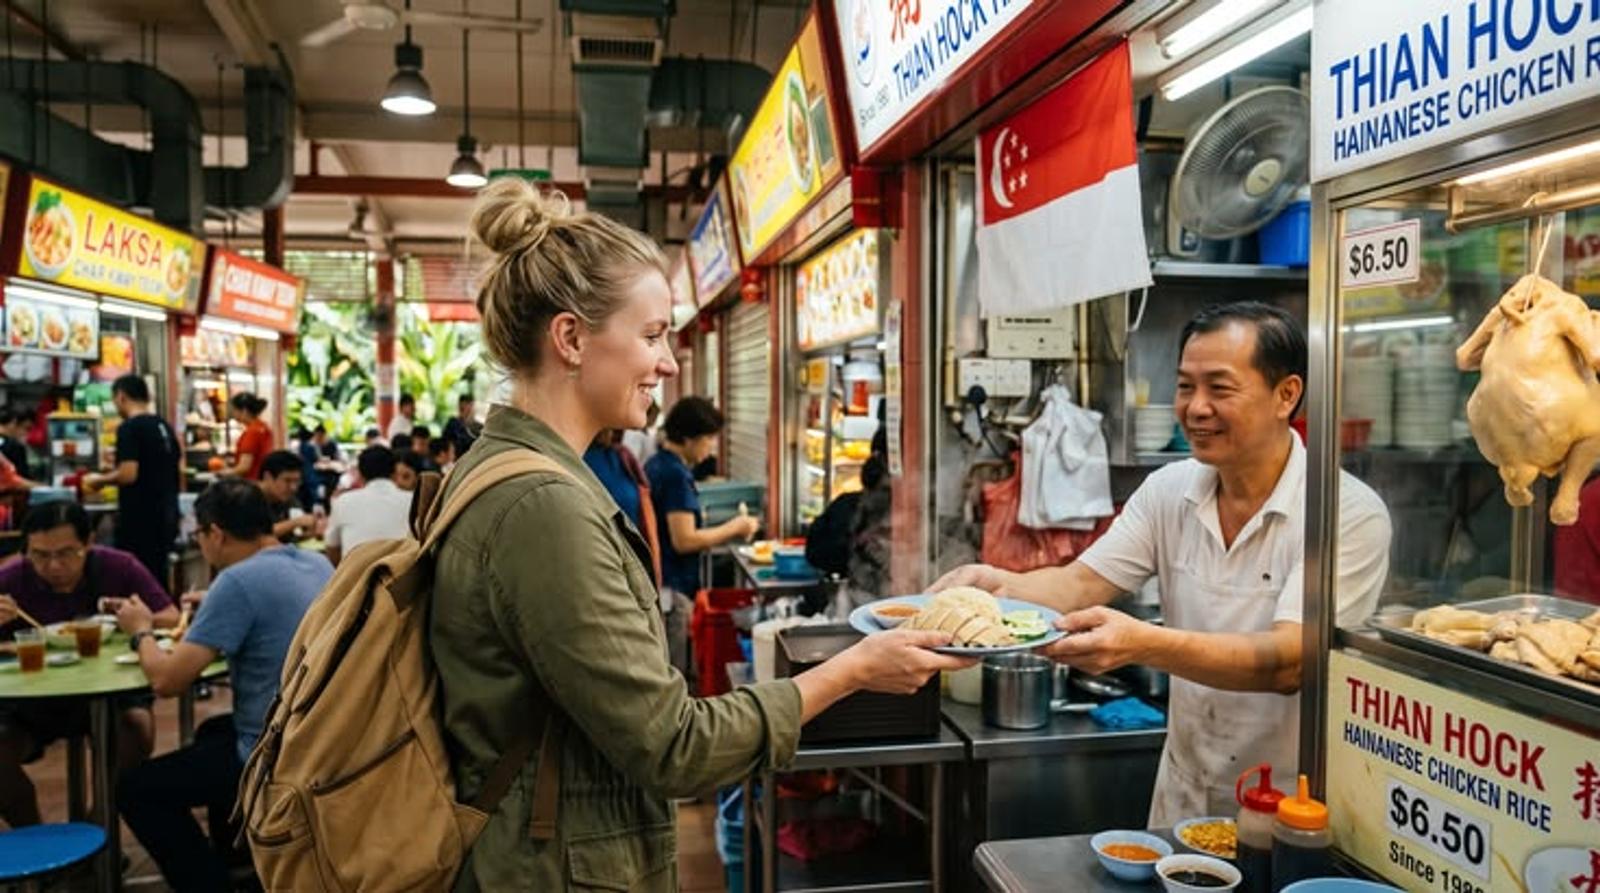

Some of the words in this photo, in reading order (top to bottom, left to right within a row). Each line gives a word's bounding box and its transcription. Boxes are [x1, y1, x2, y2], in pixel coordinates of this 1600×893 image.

[893, 30, 934, 102] THIAN
[1330, 15, 1449, 120] THIAN
[1467, 0, 1600, 70] HOC
[1334, 91, 1450, 161] HAINANESE
[1458, 45, 1575, 119] CHICKEN
[85, 213, 162, 268] LAKSA
[1349, 236, 1409, 277] $6.50
[1346, 677, 1433, 746] THIAN
[1444, 712, 1546, 792] HOCK
[1343, 721, 1423, 774] HAINANESE
[1428, 757, 1501, 810] CHICKEN
[1506, 791, 1552, 833] RICE
[1389, 840, 1435, 883] Since
[1390, 785, 1485, 865] $6.50
